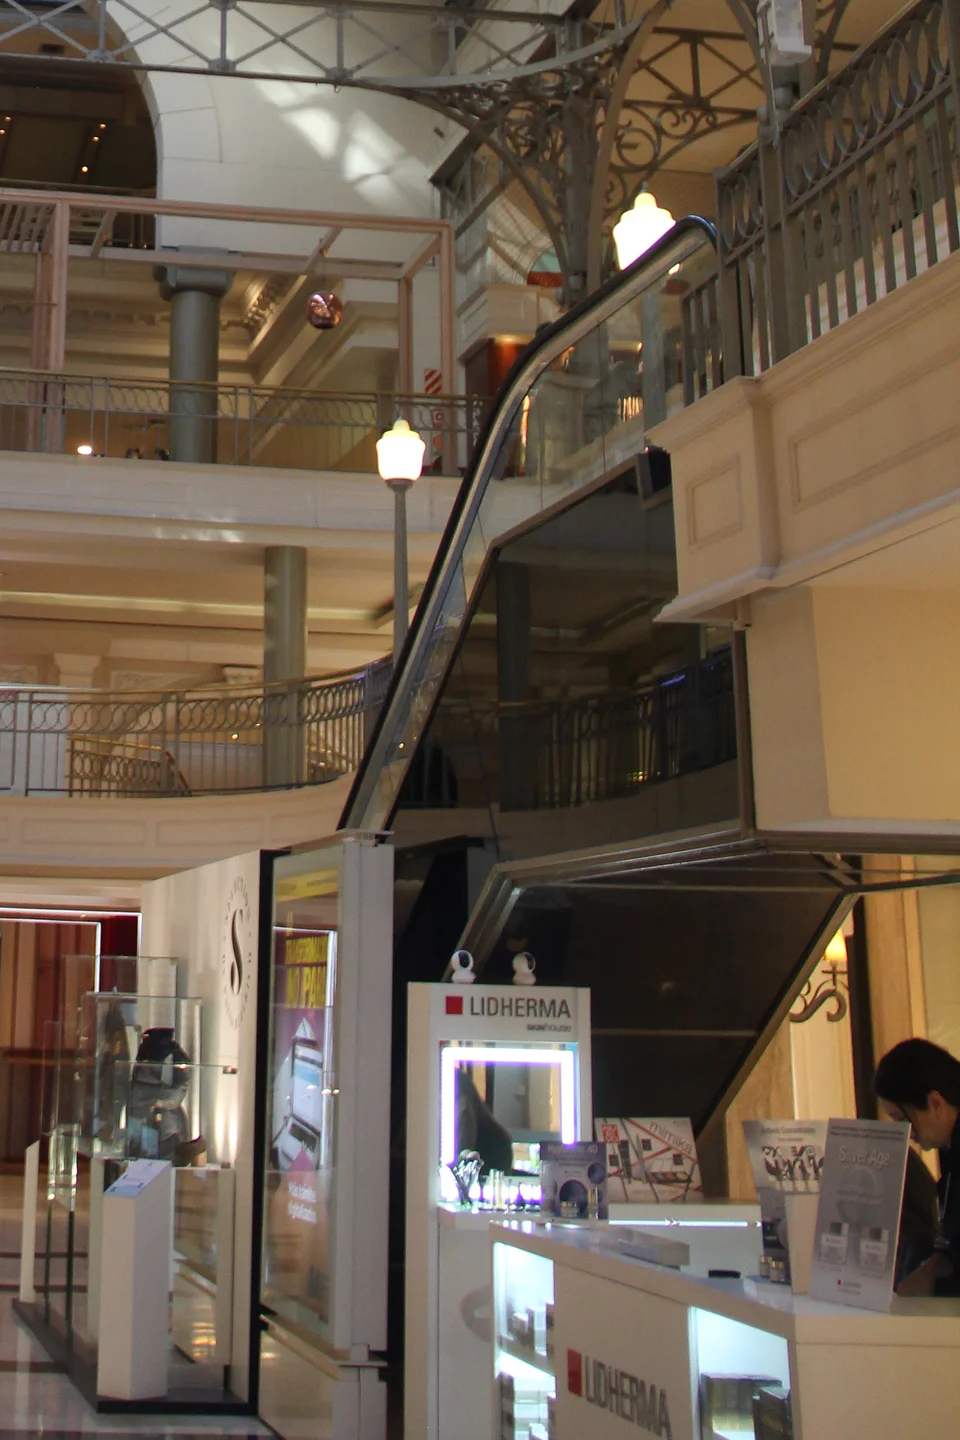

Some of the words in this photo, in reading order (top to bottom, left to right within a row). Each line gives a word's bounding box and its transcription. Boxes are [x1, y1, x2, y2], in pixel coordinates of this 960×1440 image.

[470, 996, 572, 1018] LIDHERMA
[650, 1120, 693, 1154] mimika
[870, 1147, 890, 1169] Age
[585, 1356, 673, 1440] LIDHERMA
